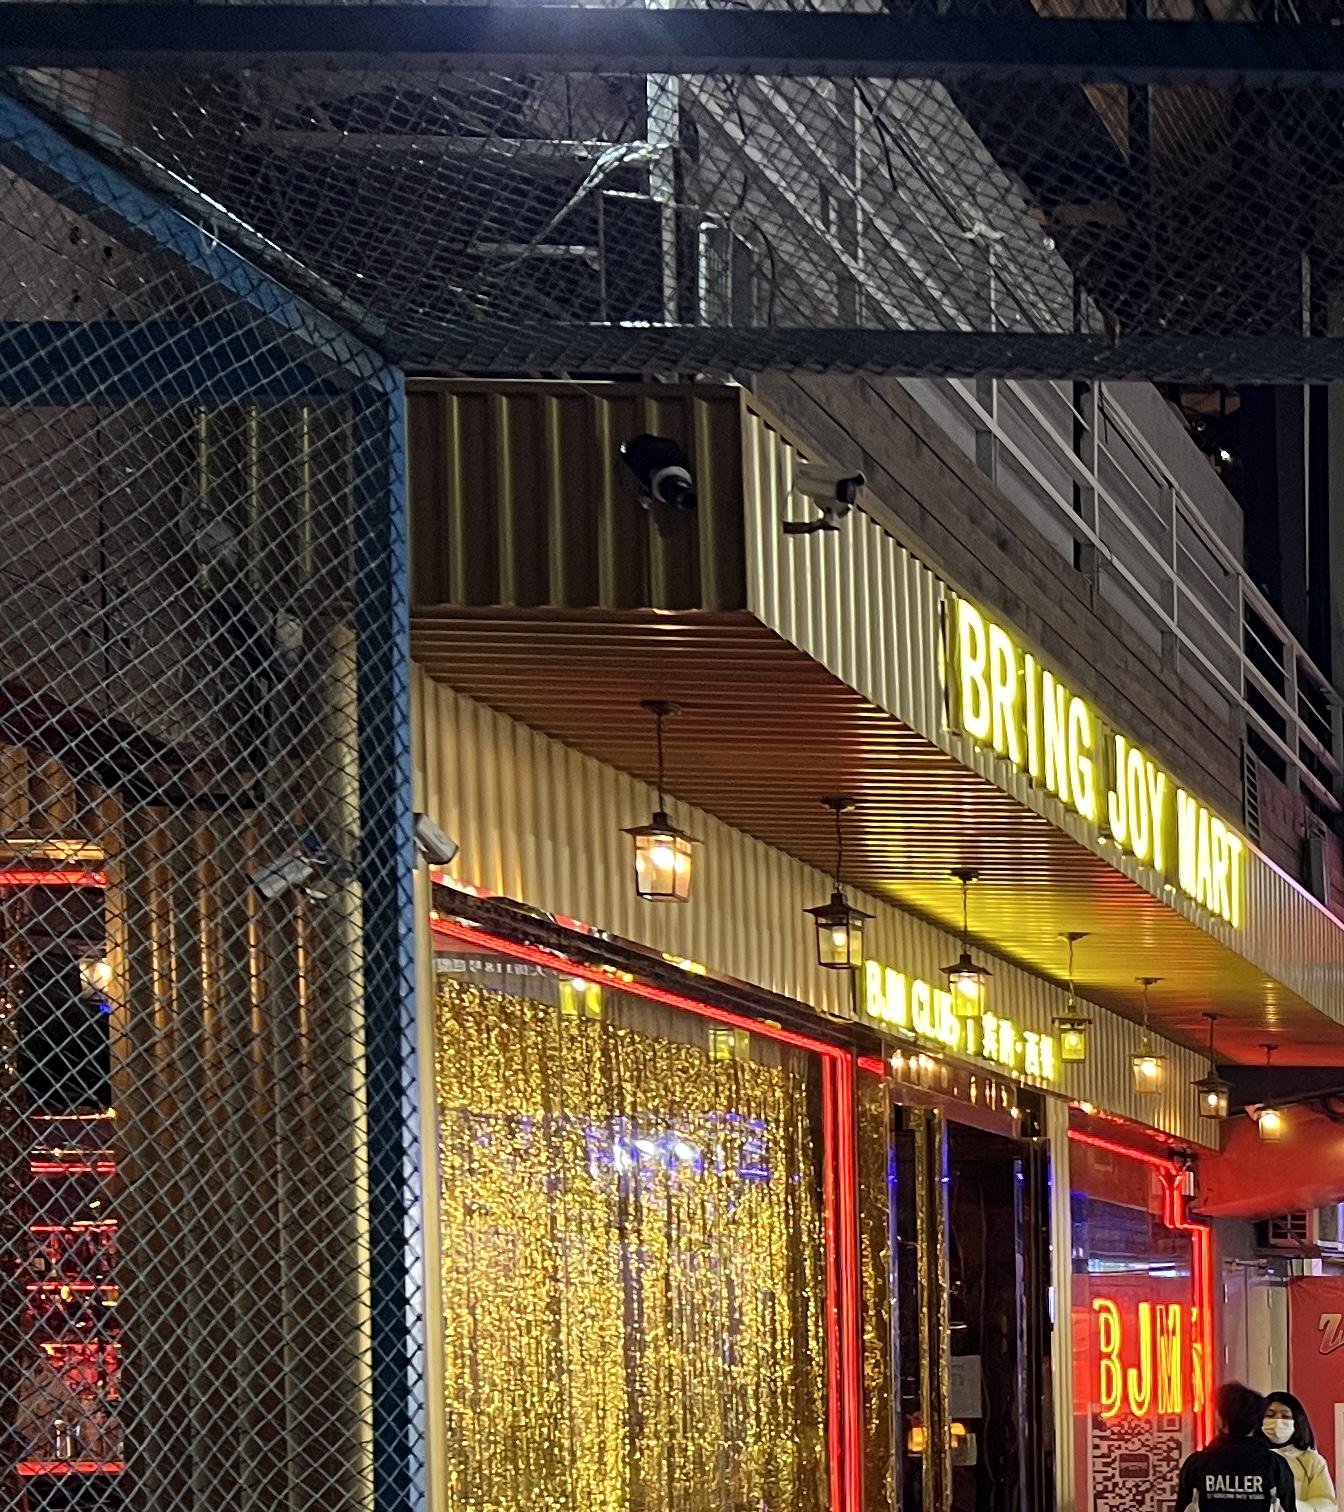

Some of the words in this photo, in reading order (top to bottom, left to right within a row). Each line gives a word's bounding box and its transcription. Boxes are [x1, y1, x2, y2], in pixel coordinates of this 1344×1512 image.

[958, 598, 1097, 822] BRING
[1109, 733, 1166, 872] JOY
[1176, 788, 1245, 928] MART
[1205, 1474, 1264, 1493] BALLER
